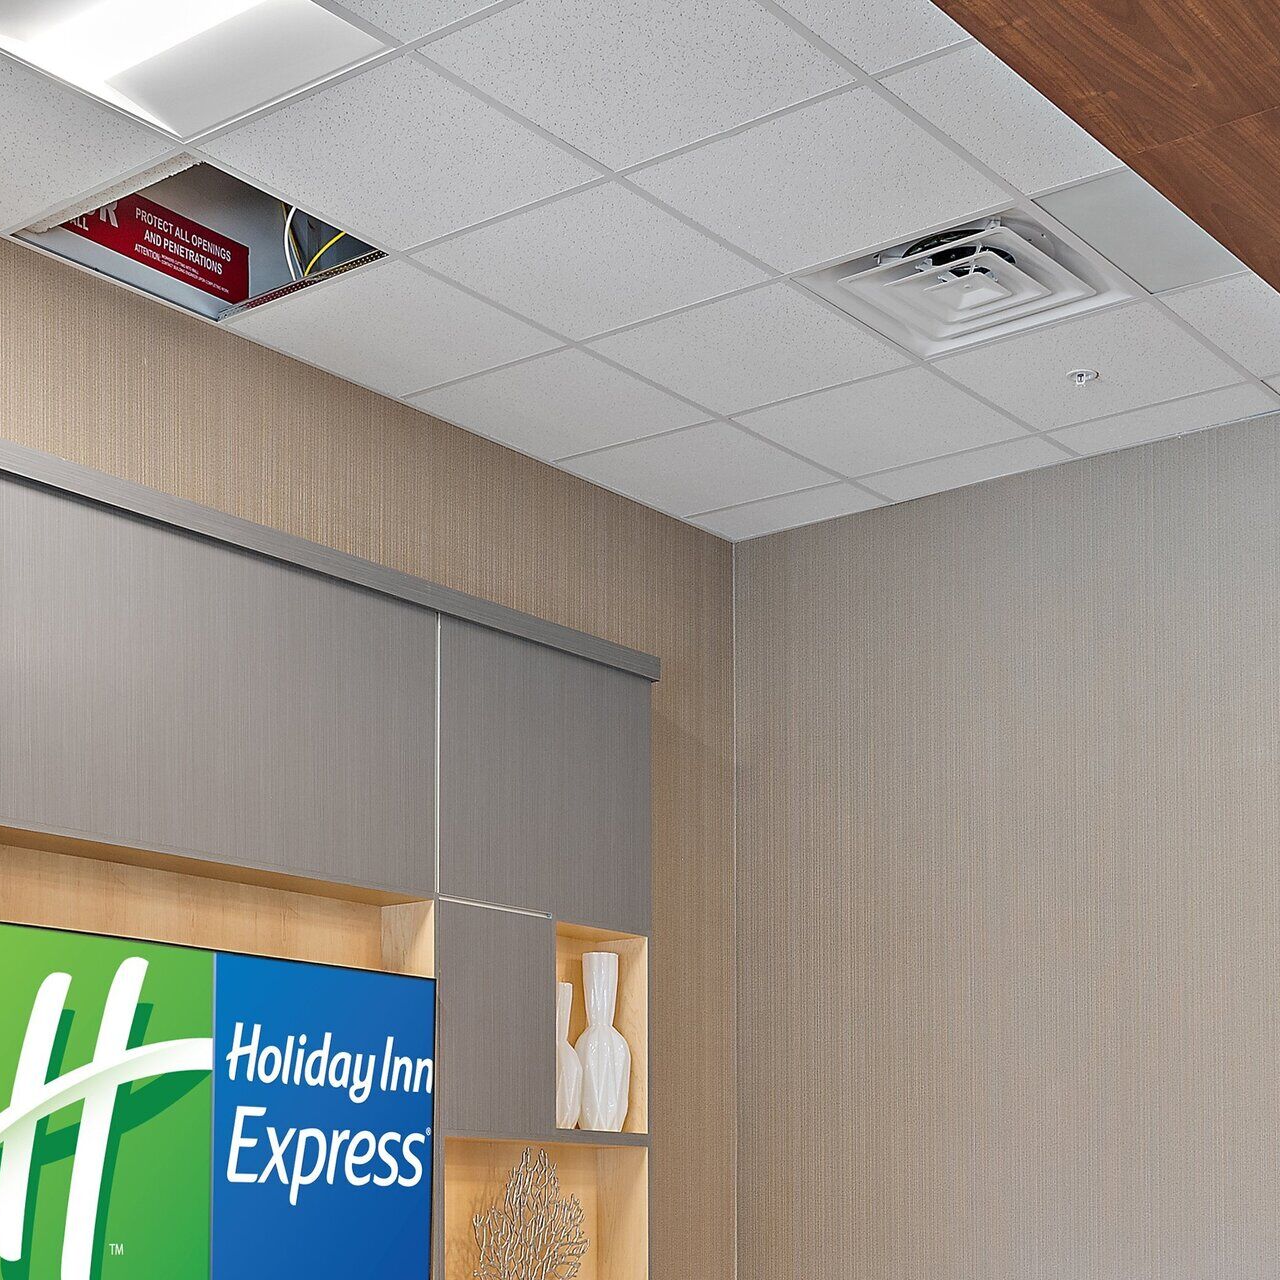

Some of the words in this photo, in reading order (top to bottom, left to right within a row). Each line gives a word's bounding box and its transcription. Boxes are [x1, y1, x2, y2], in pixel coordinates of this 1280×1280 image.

[135, 207, 173, 235] PROTECT
[174, 228, 190, 243] ALL
[191, 234, 232, 262] OPENINGS
[144, 230, 162, 247] AND
[163, 238, 223, 275] PENETRATIONS
[225, 1021, 376, 1103] Holiday
[380, 1036, 433, 1093] Inn
